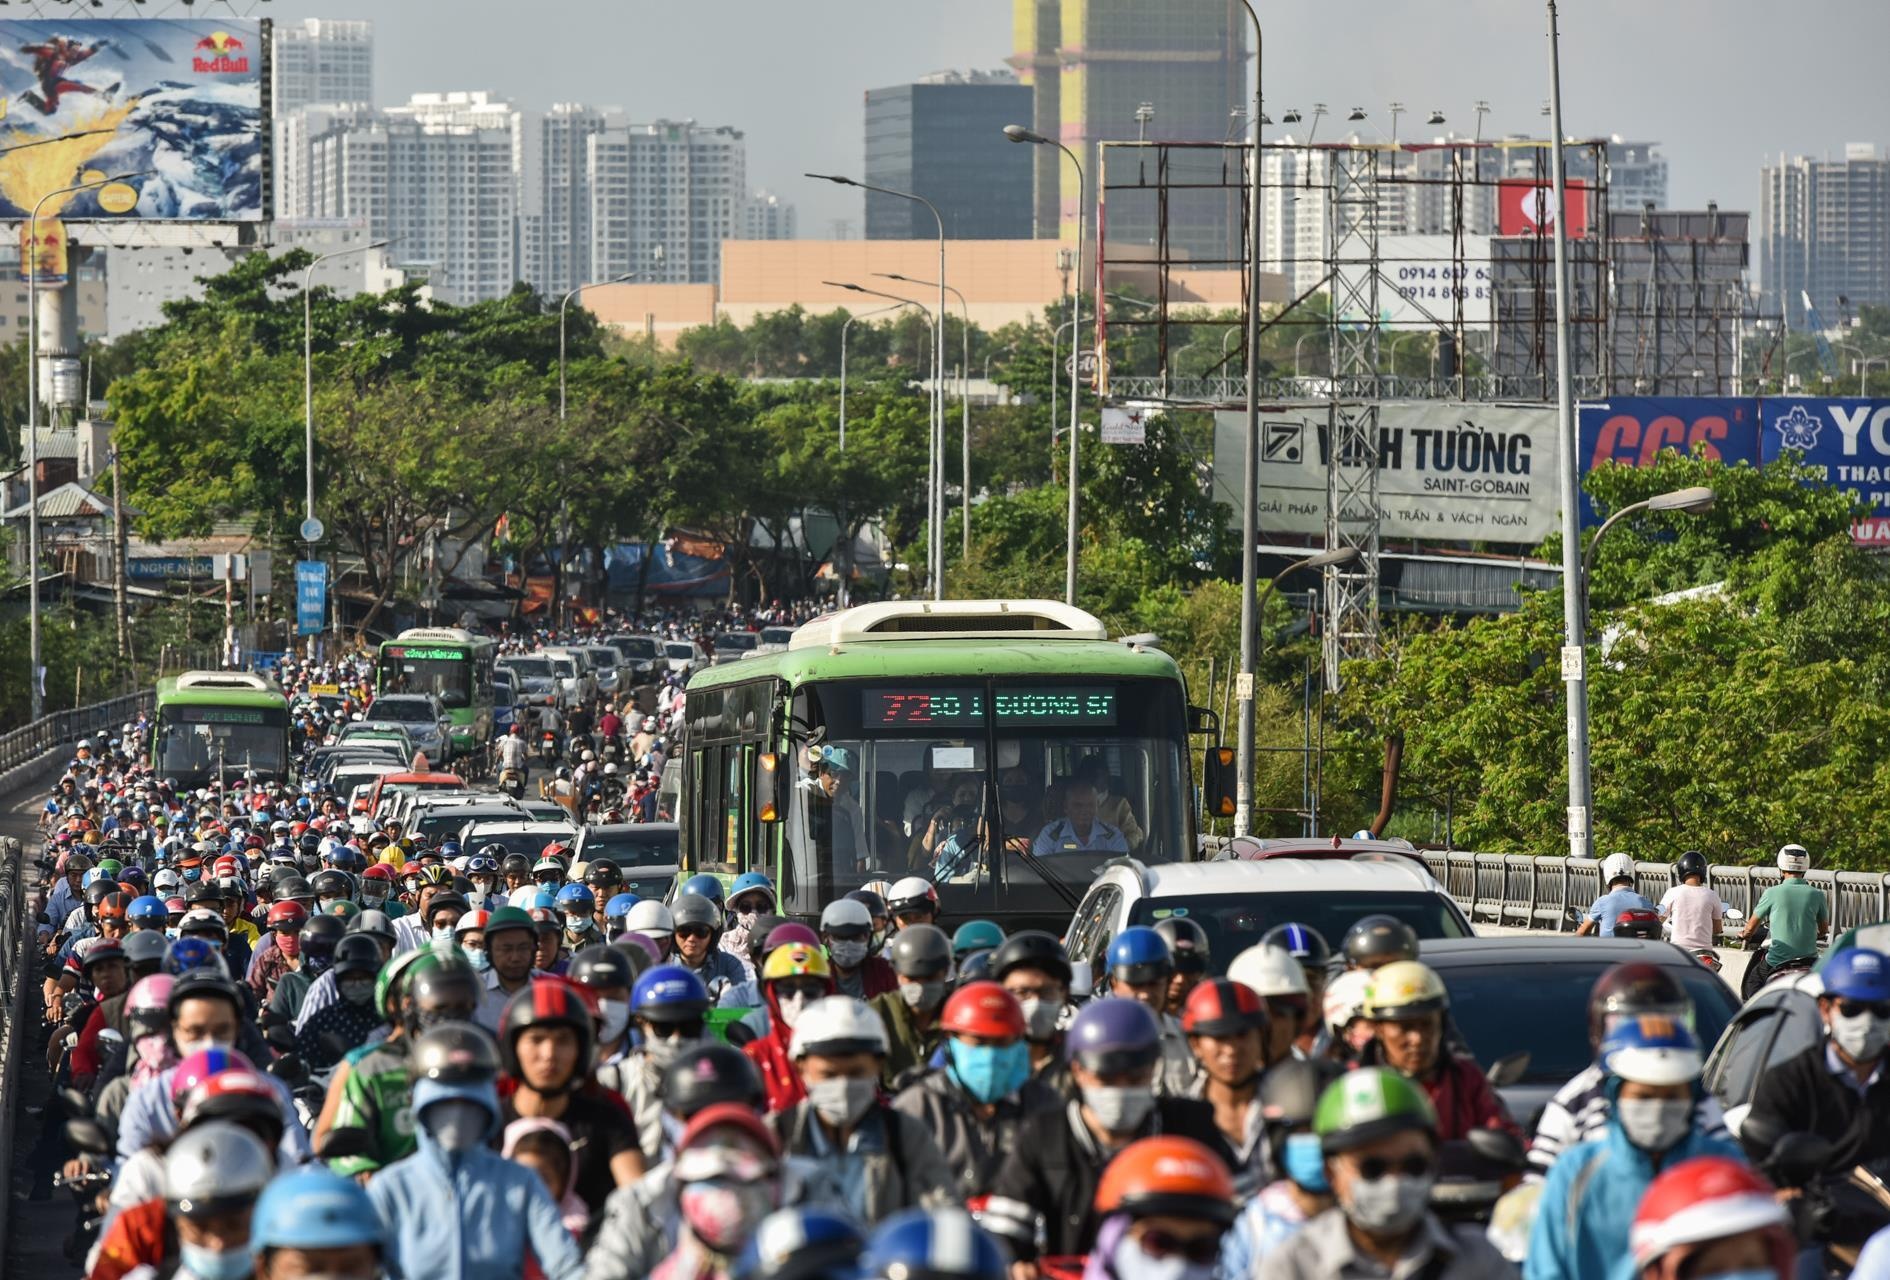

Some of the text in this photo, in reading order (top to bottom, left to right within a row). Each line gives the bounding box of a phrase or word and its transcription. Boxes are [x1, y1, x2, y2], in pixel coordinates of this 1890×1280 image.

[1399, 267, 1436, 280] 0914
[1399, 286, 1436, 300] 0914
[1411, 420, 1531, 475] TƯỜNG
[1424, 477, 1530, 495] SAINT-GOBAIN
[1437, 512, 1445, 522] &
[1452, 512, 1483, 524] VÁCH
